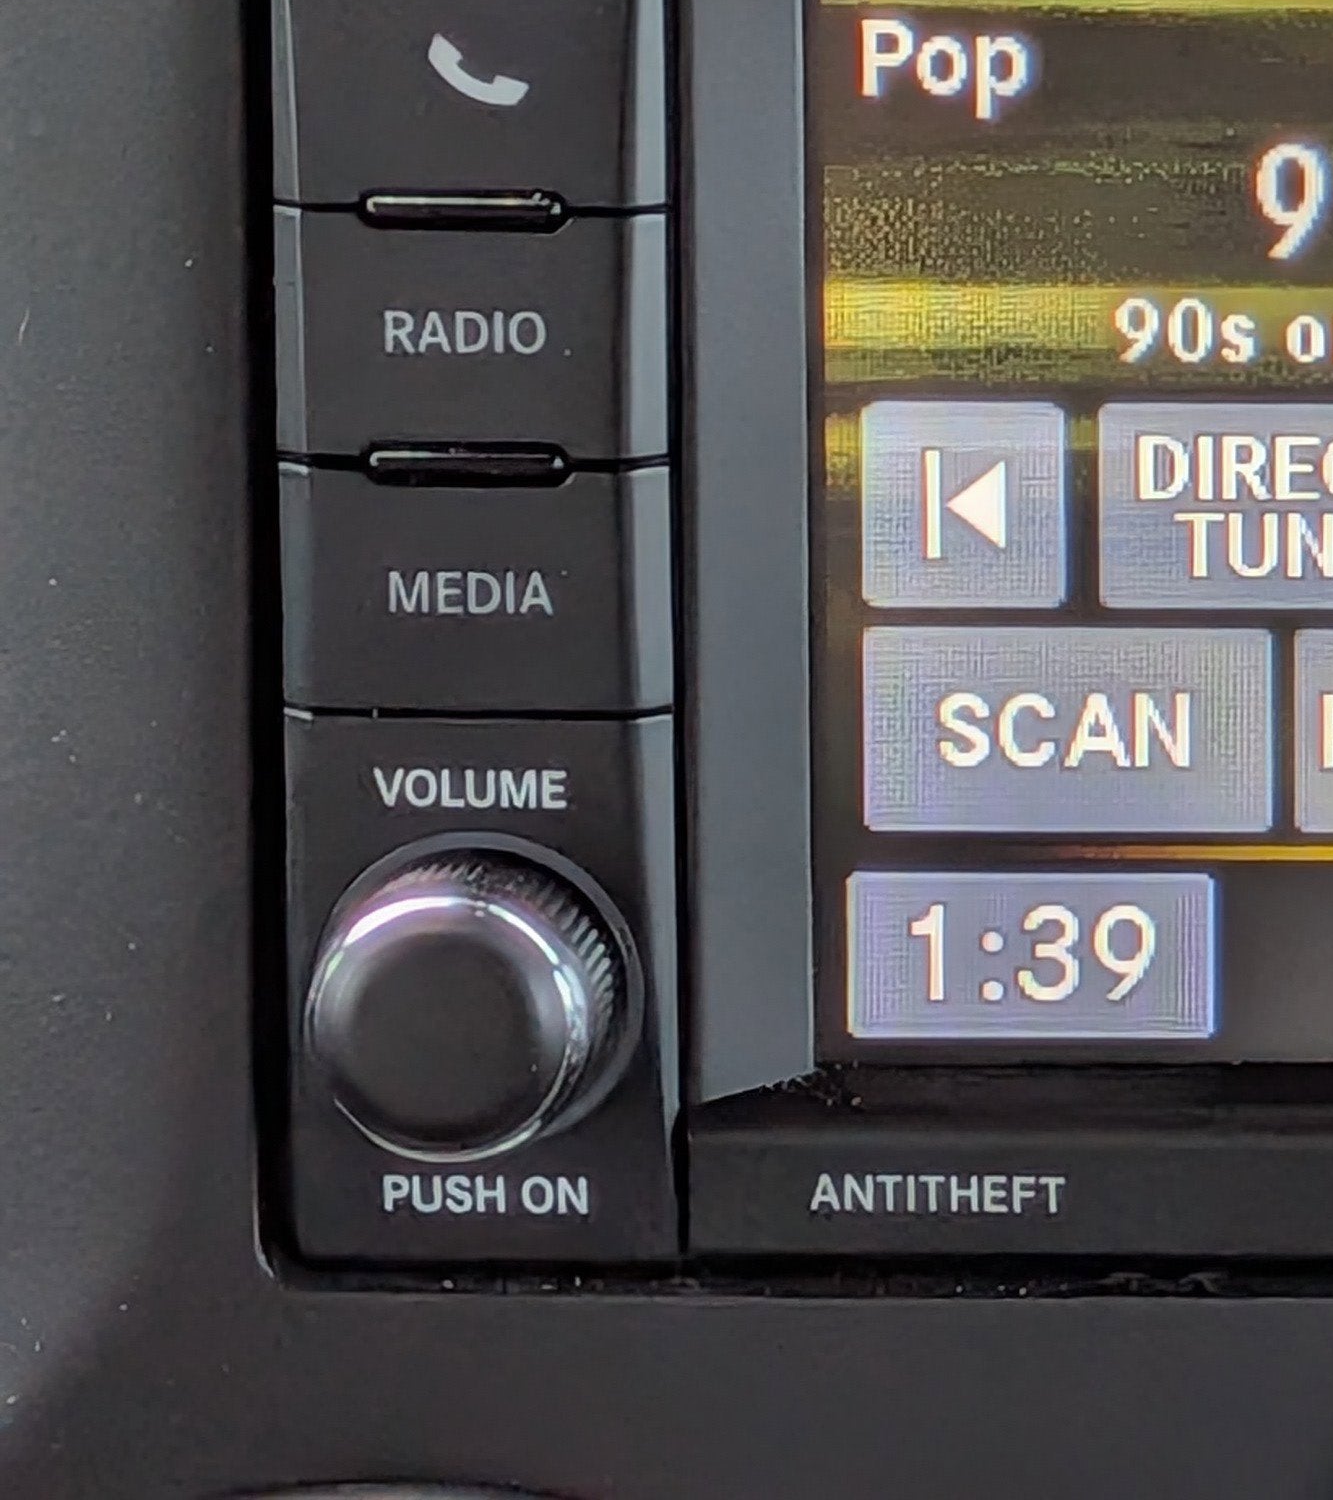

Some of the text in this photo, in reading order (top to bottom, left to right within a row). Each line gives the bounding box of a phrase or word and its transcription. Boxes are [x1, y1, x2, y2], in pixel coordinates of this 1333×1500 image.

[858, 17, 1031, 120] Pop
[1254, 142, 1330, 261] 9
[383, 309, 548, 356] RADIO
[1114, 298, 1256, 363] 90s
[387, 570, 554, 616] MEDIA
[937, 692, 1191, 769] SCAN
[372, 766, 568, 811] VOLUME
[909, 903, 1156, 1002] 1:39
[381, 1174, 590, 1215] PUSH ON
[810, 1174, 1066, 1214] ANTITHEFT
